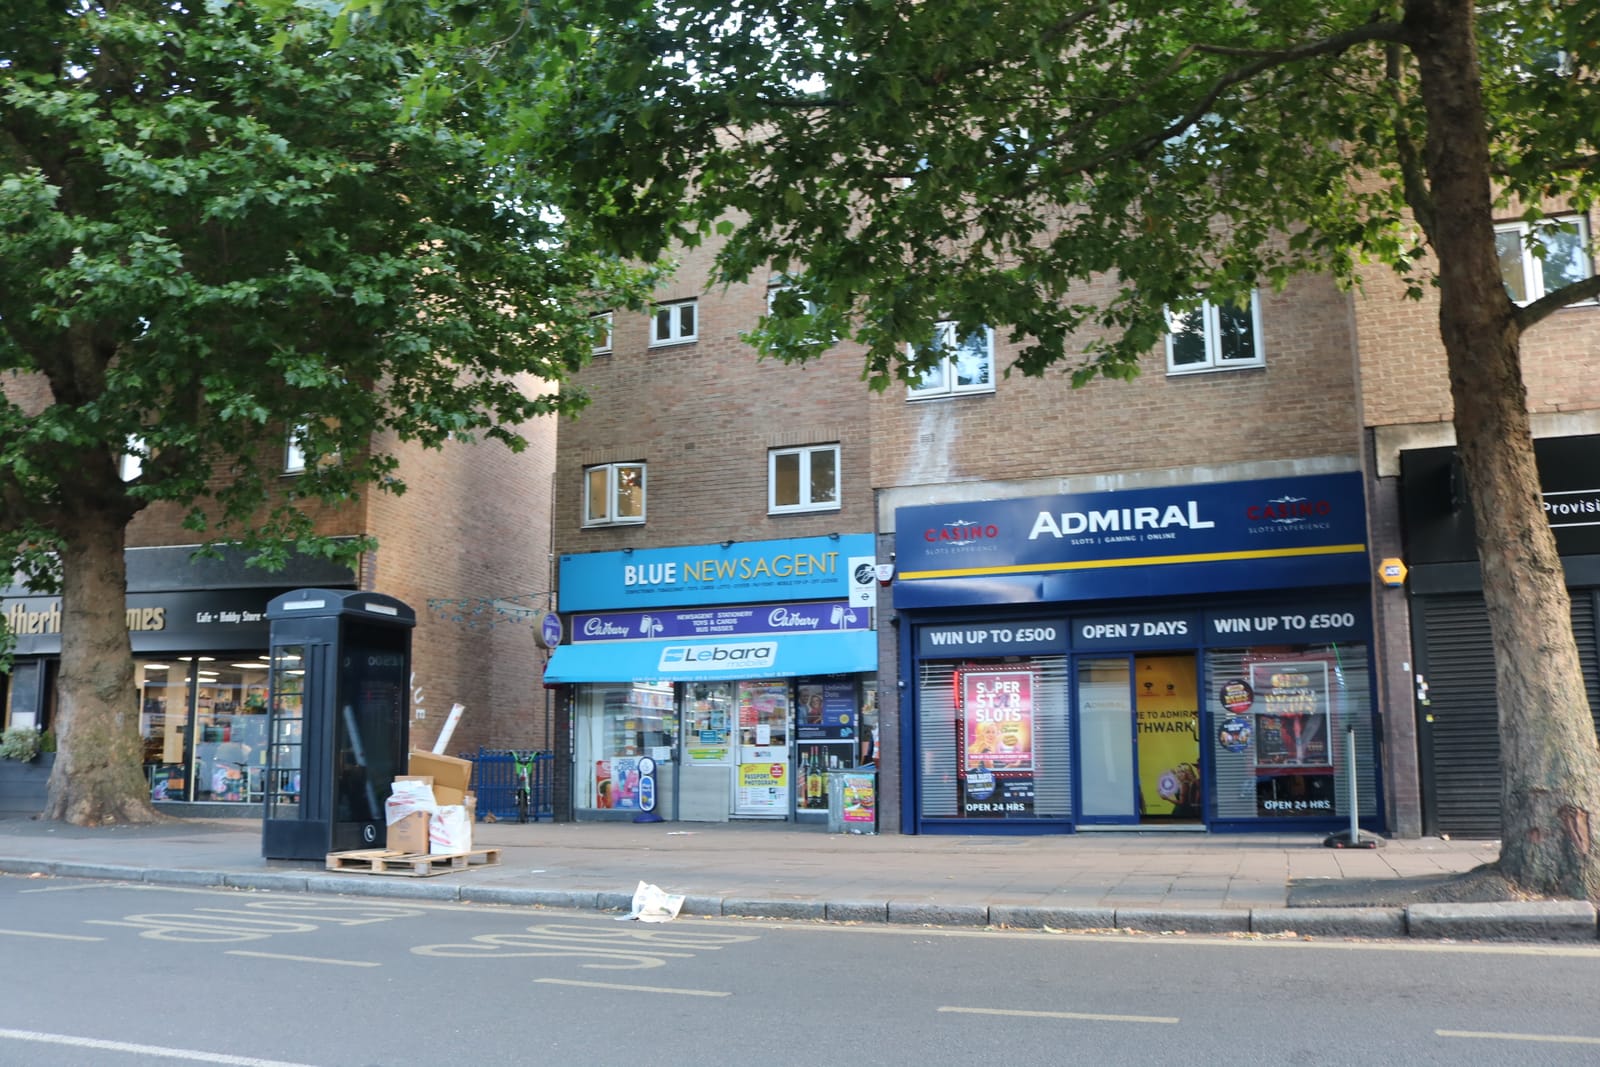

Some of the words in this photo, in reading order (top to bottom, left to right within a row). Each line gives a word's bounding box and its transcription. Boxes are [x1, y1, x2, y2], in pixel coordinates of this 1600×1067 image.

[1247, 500, 1331, 520] CASINO
[1028, 501, 1215, 540] ADMIRAL
[924, 524, 999, 542] CASINO
[1071, 537, 1095, 545] SLOTS
[1104, 535, 1137, 543] GAMING
[1147, 532, 1177, 540] ONLINE
[624, 562, 676, 586] BLUE
[683, 552, 839, 583] NEWSAGENT
[196, 611, 212, 623] Cafe
[219, 611, 241, 624] Hobby
[242, 611, 261, 622] Store
[677, 613, 714, 621] NEWSAGENT
[768, 607, 820, 629] Cadbury
[1214, 618, 1251, 633] WIN
[1254, 617, 1278, 631] UP
[1281, 615, 1306, 630] TO
[1310, 613, 1355, 629] £500
[584, 617, 630, 637] Cadbury
[1082, 624, 1127, 639] OPEN
[1130, 623, 1139, 637] 7
[1143, 620, 1188, 636] DAYS
[931, 632, 963, 645] WIN
[967, 631, 988, 644] UP
[991, 629, 1012, 643] TO
[1016, 628, 1056, 642] £500
[685, 647, 771, 662] Lebara
[976, 709, 1022, 722] SLOTS
[1147, 711, 1158, 719] TO
[966, 803, 991, 812] OPEN
[992, 803, 1004, 811] 24
[1006, 802, 1025, 811] HRS
[1264, 800, 1292, 810] OPEN
[1294, 800, 1307, 809] 24
[1309, 800, 1330, 809] HRS
